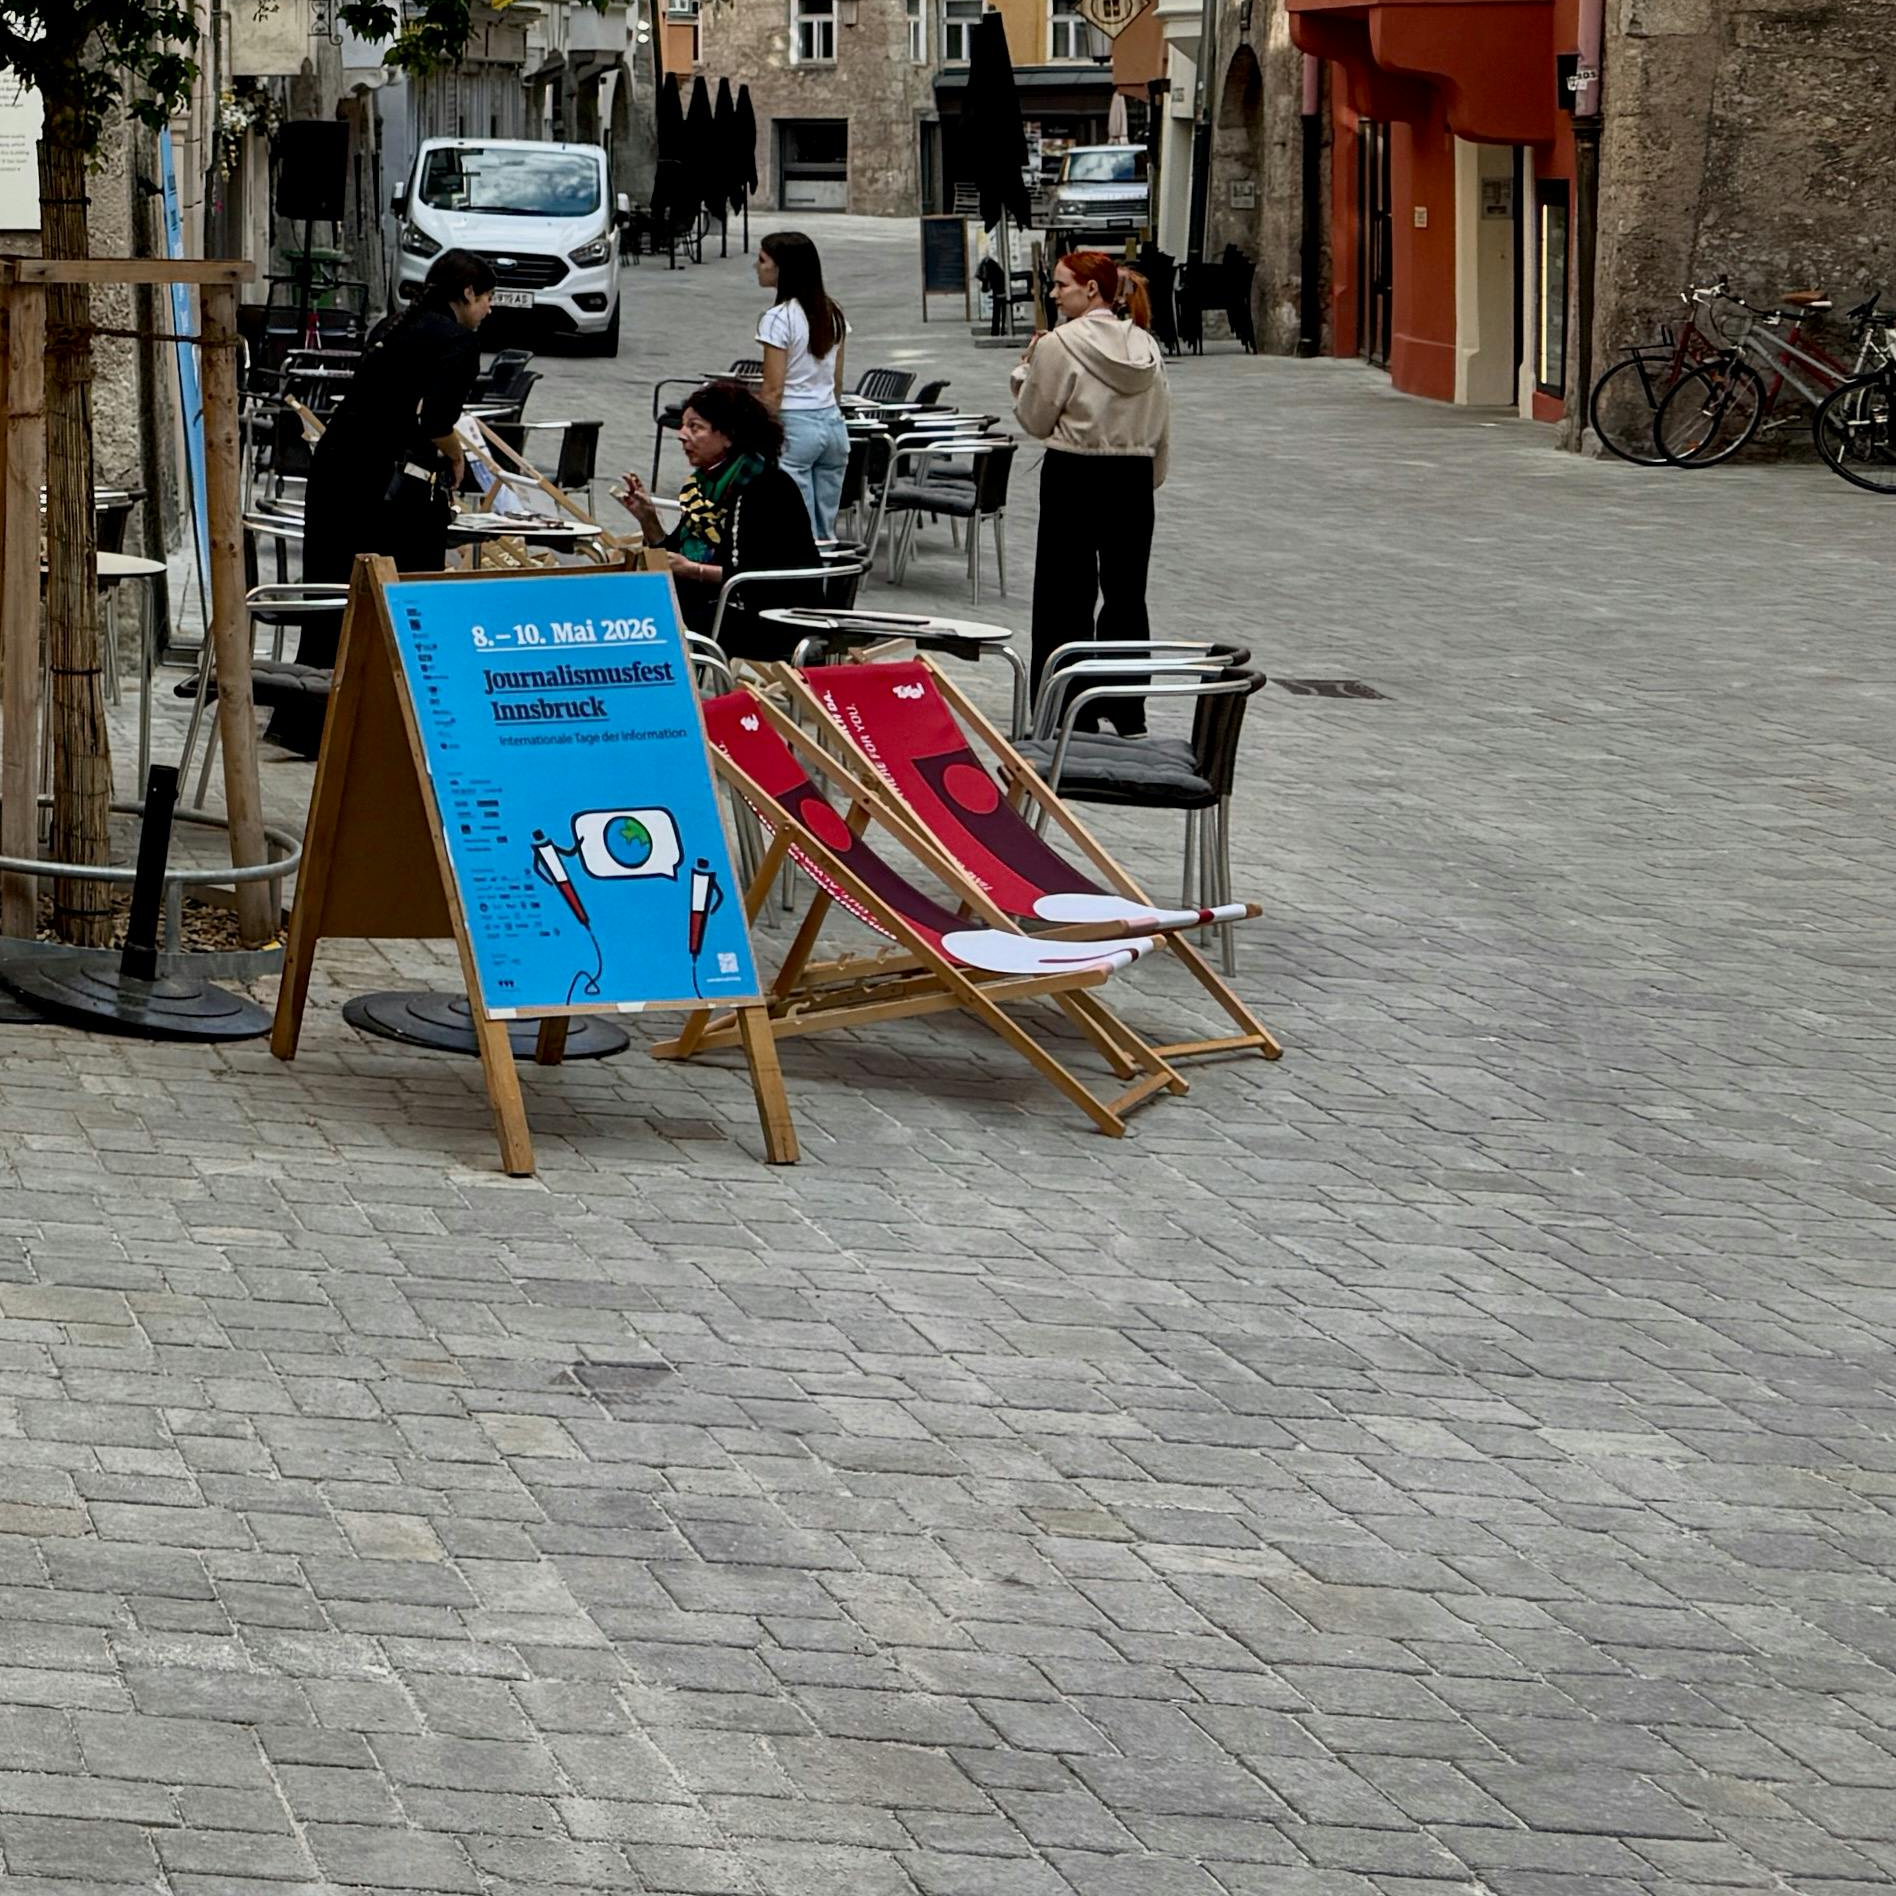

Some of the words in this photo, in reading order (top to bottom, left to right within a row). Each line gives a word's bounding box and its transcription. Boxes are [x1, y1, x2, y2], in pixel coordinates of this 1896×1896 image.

[550, 619, 595, 644] Mai
[601, 617, 657, 641] 2026
[483, 661, 675, 695] Journalismusfest
[491, 696, 608, 722] Innsbruck
[499, 726, 573, 747] Internationale
[575, 731, 599, 747] Tage
[601, 729, 620, 744] der
[621, 727, 687, 743] Information
